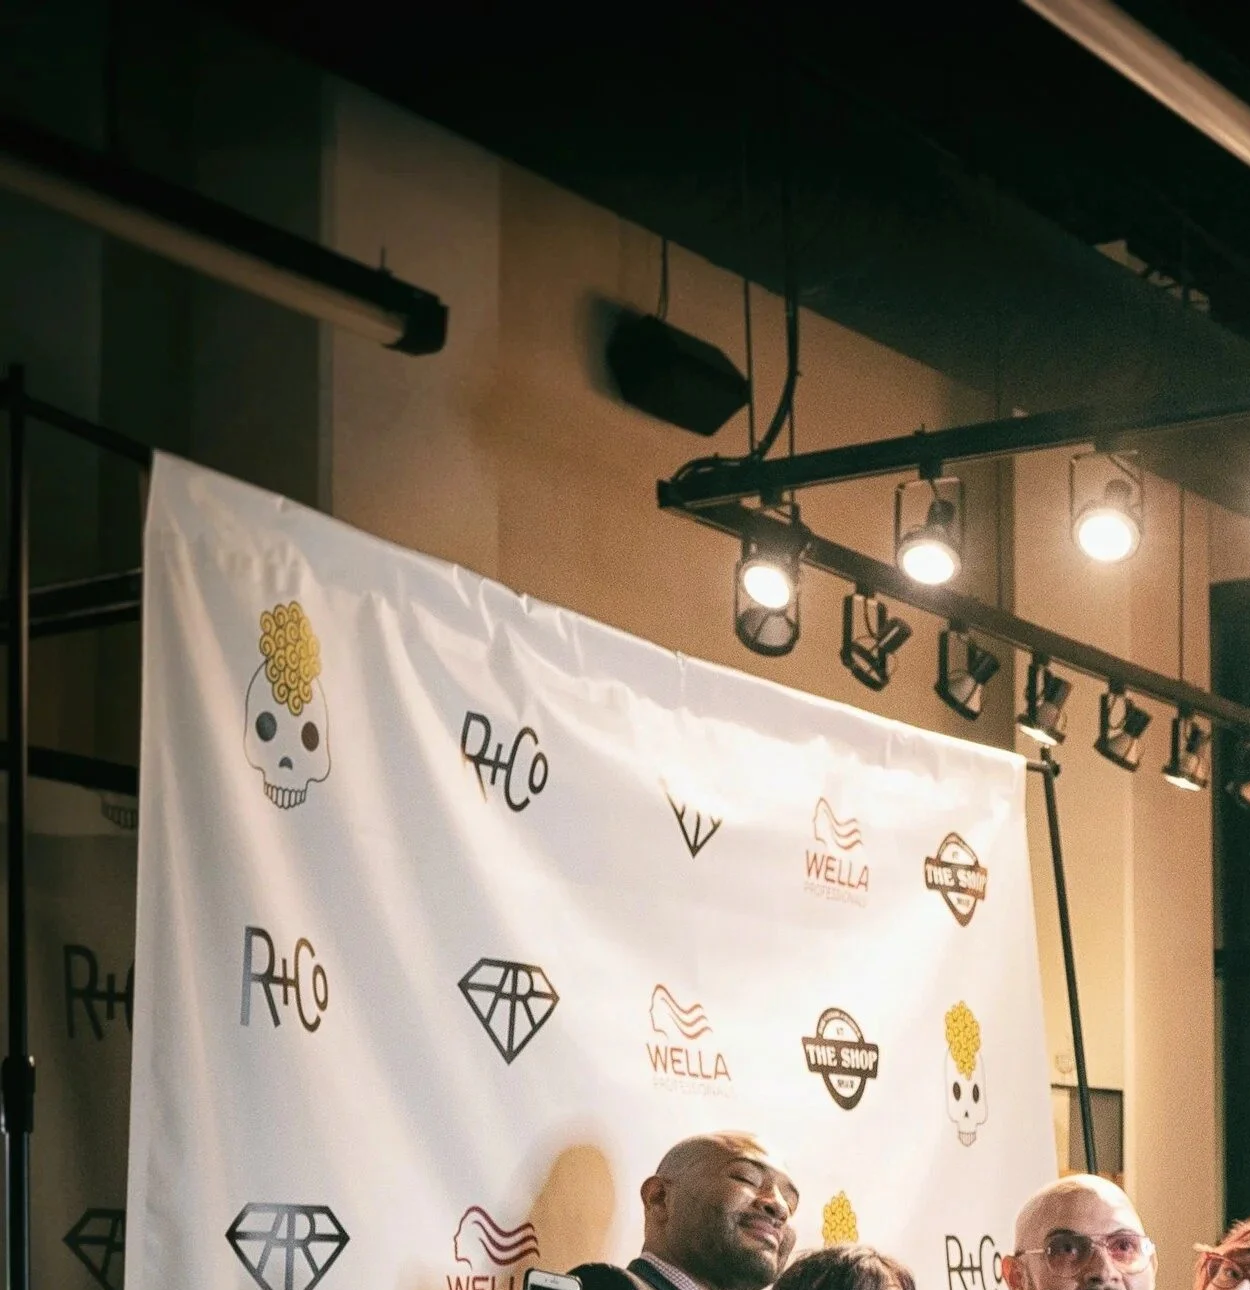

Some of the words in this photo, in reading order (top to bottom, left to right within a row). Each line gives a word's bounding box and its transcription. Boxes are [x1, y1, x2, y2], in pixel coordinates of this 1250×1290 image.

[460, 711, 548, 812] R+Co
[805, 850, 869, 892] WELLA
[240, 926, 328, 1033] R+Co
[646, 1043, 731, 1081] WELLA
[806, 1044, 837, 1068] THE
[839, 1045, 877, 1071] SHOP
